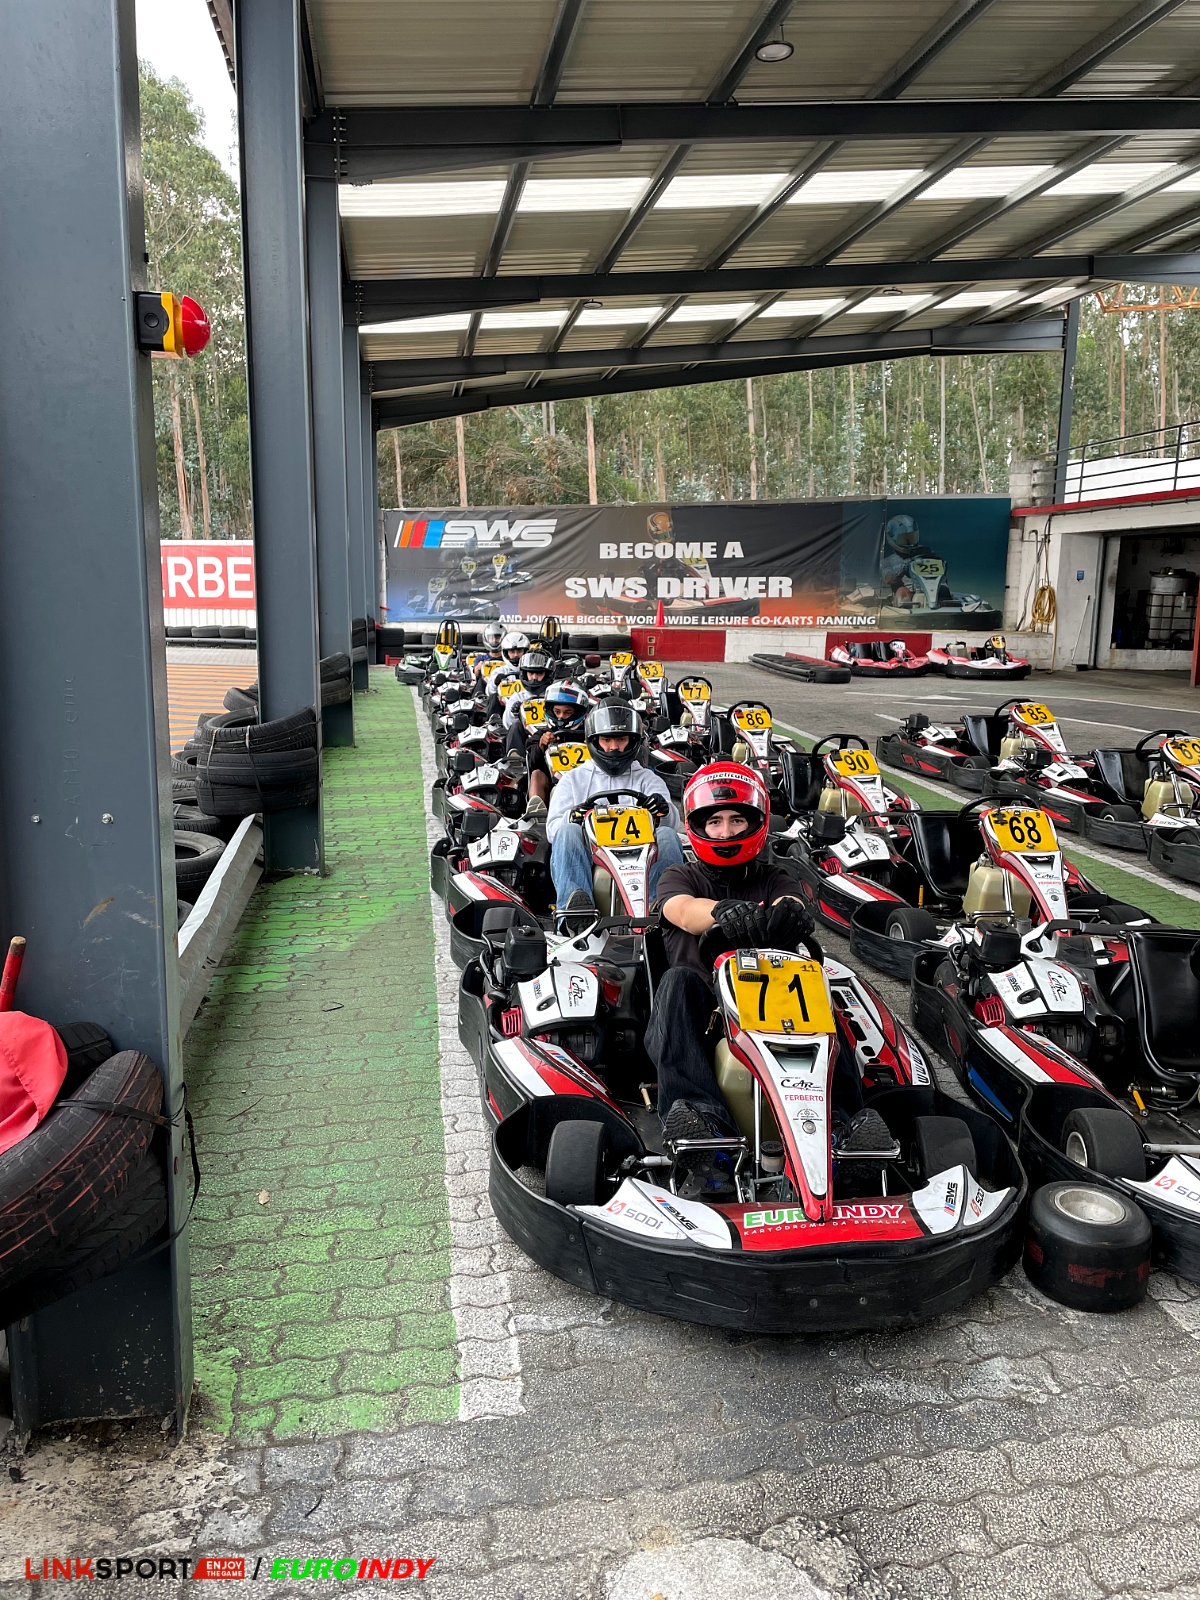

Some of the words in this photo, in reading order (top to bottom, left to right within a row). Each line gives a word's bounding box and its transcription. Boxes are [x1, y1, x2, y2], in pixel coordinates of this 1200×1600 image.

[440, 519, 558, 548] SWS
[600, 542, 717, 559] BECOME
[724, 541, 744, 559] A
[919, 564, 940, 573] 25
[565, 577, 648, 598] SWS
[657, 577, 793, 599] DRIVER
[498, 614, 522, 623] AND
[576, 615, 624, 624] BIGGEST
[625, 615, 699, 625] WORWIDE
[701, 616, 749, 625] LEISURE
[751, 616, 813, 625] GO-KARTS
[816, 616, 876, 625] RANKING
[614, 656, 627, 664] 87
[645, 665, 659, 677] 83
[688, 687, 703, 698] 77
[745, 712, 765, 726] 86
[1026, 707, 1048, 721] 85
[558, 747, 586, 766] 62
[843, 754, 870, 771] 90
[604, 816, 641, 841] 74
[1008, 816, 1042, 844] 68
[754, 973, 810, 1023] 71
[784, 1094, 824, 1102] FERBERTO
[1174, 1185, 1200, 1204] SO
[663, 1206, 699, 1231] SWS
[744, 1204, 904, 1229] EURINDY
